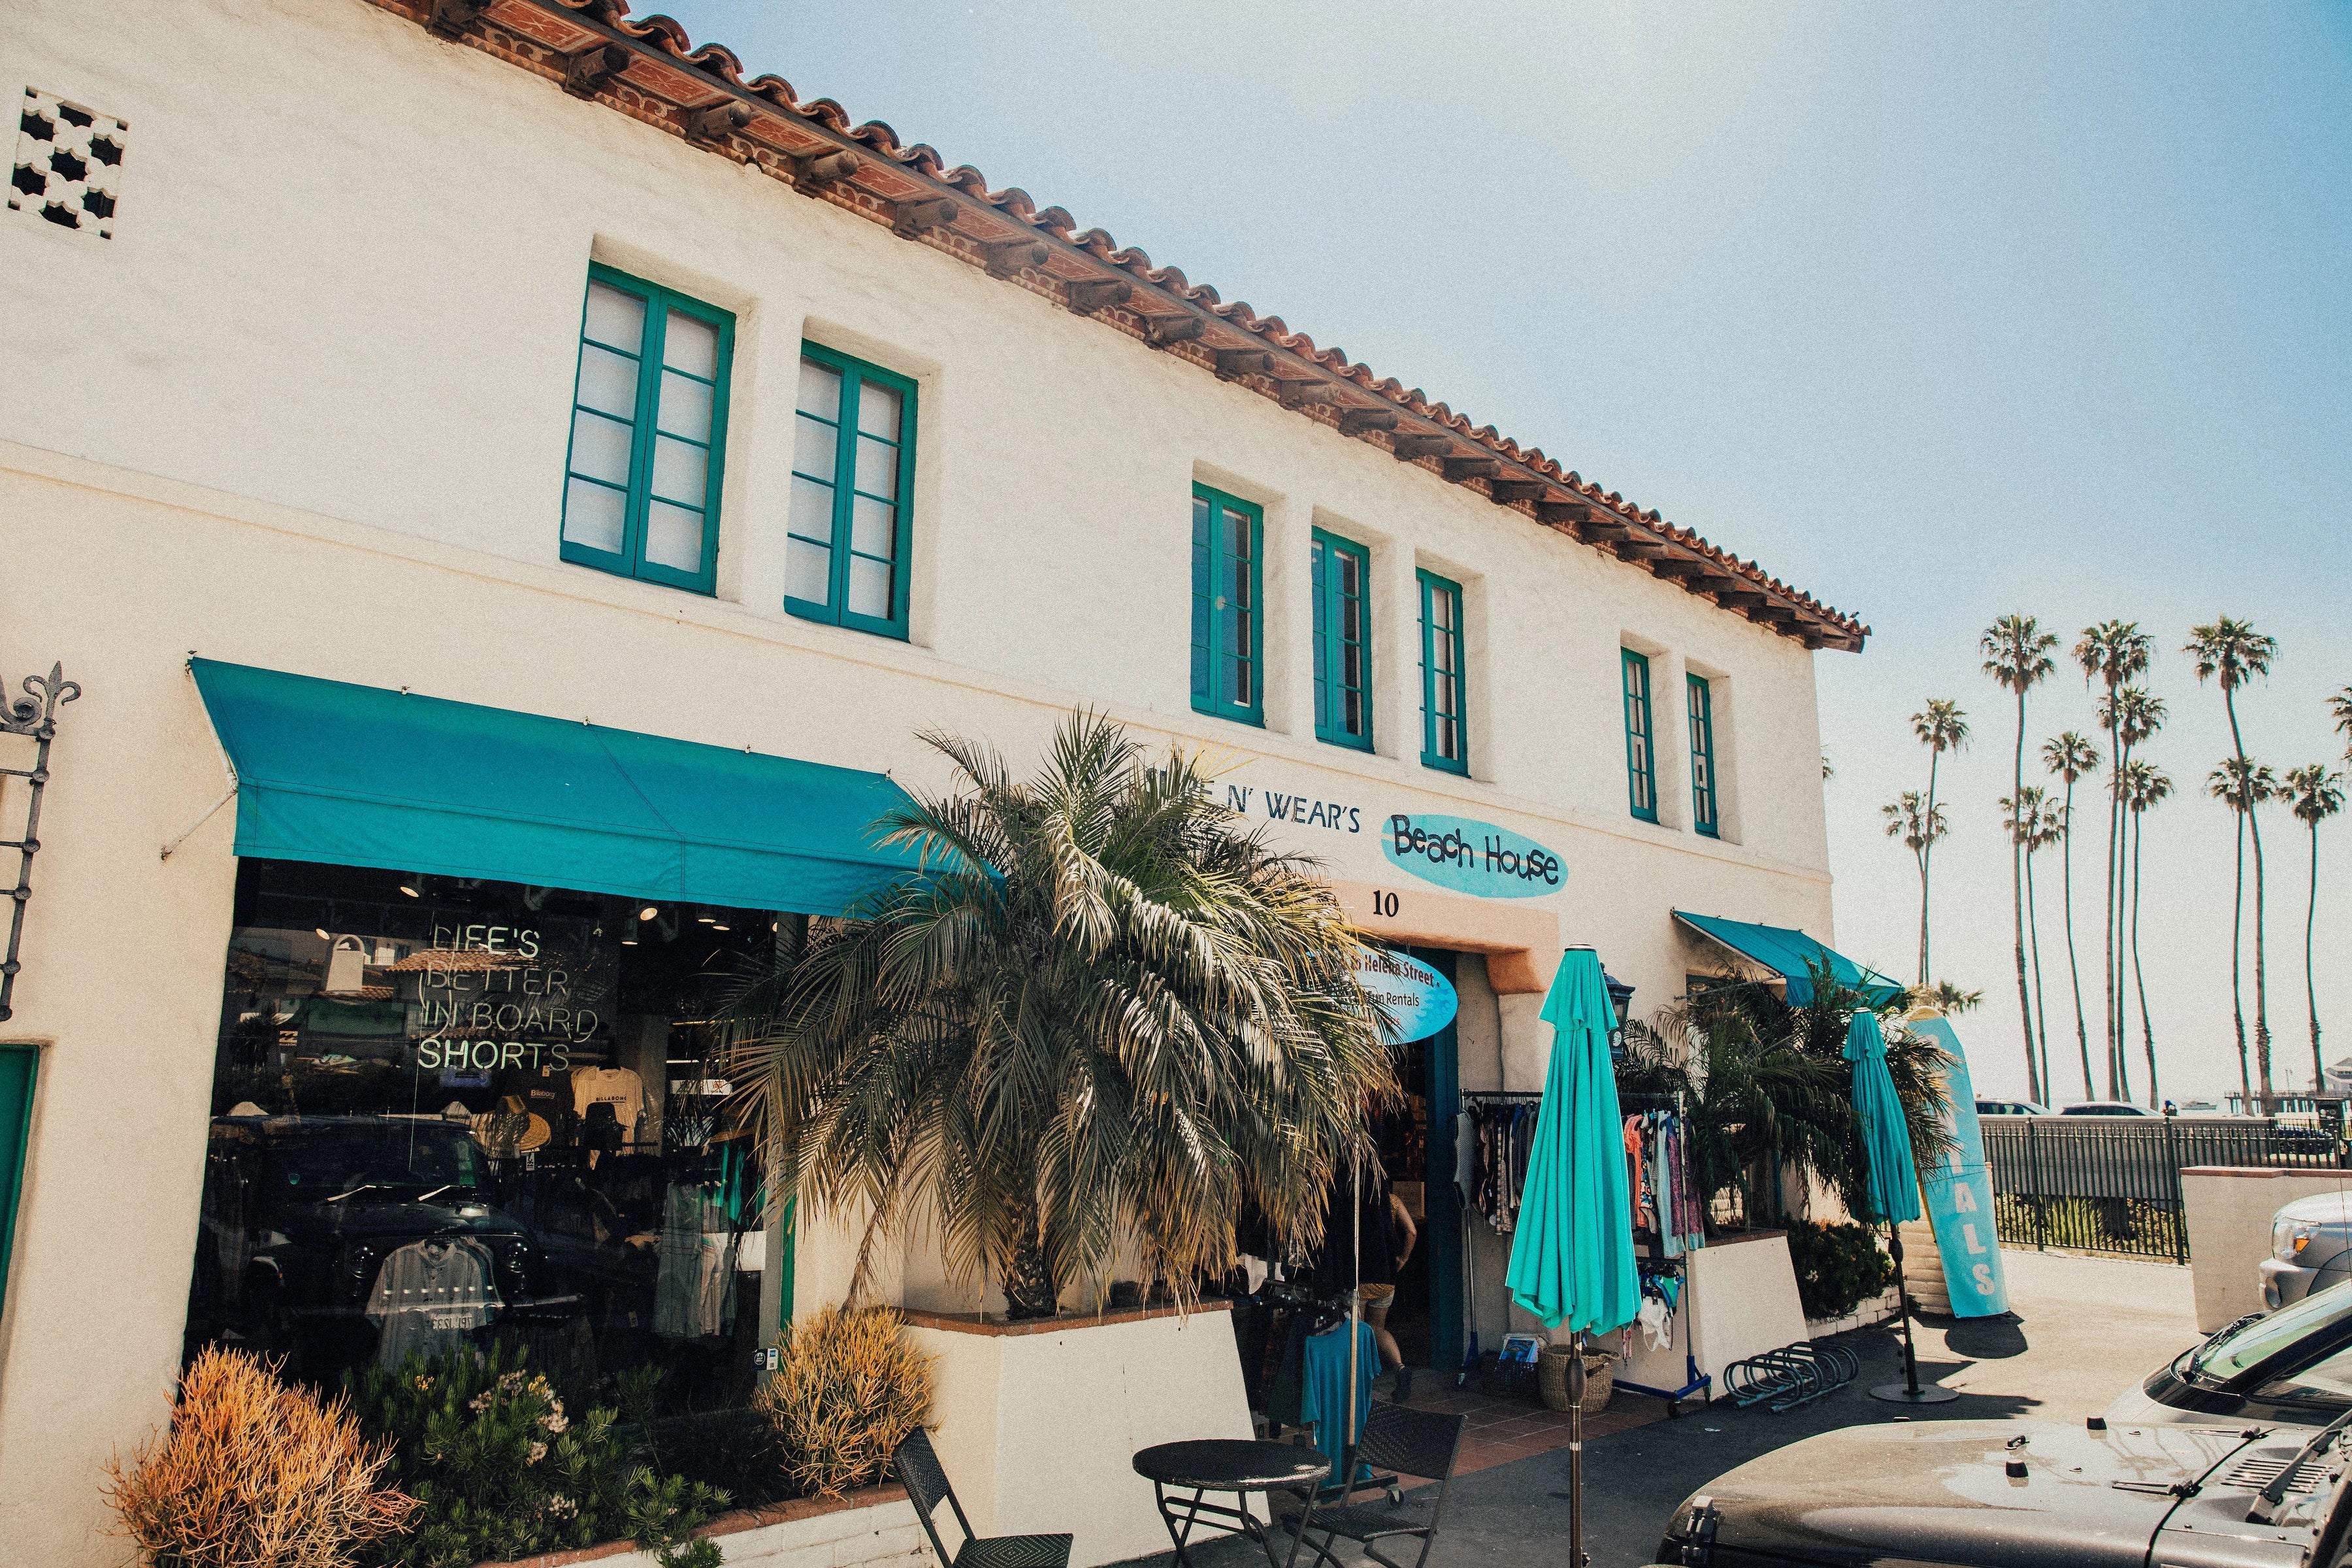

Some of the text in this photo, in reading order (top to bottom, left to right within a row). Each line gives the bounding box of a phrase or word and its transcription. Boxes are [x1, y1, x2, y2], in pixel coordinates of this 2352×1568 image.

[1227, 784, 1360, 833] N' WEAR'S
[1390, 814, 1560, 885] Beach House
[1373, 890, 1399, 919] 10
[434, 924, 539, 958] LIFE'S
[427, 961, 568, 995] BETTER
[1403, 961, 1434, 988] Street
[1386, 992, 1420, 1007] Rentals
[425, 1000, 598, 1043] IN BOARD
[419, 1039, 569, 1071] SHORTS
